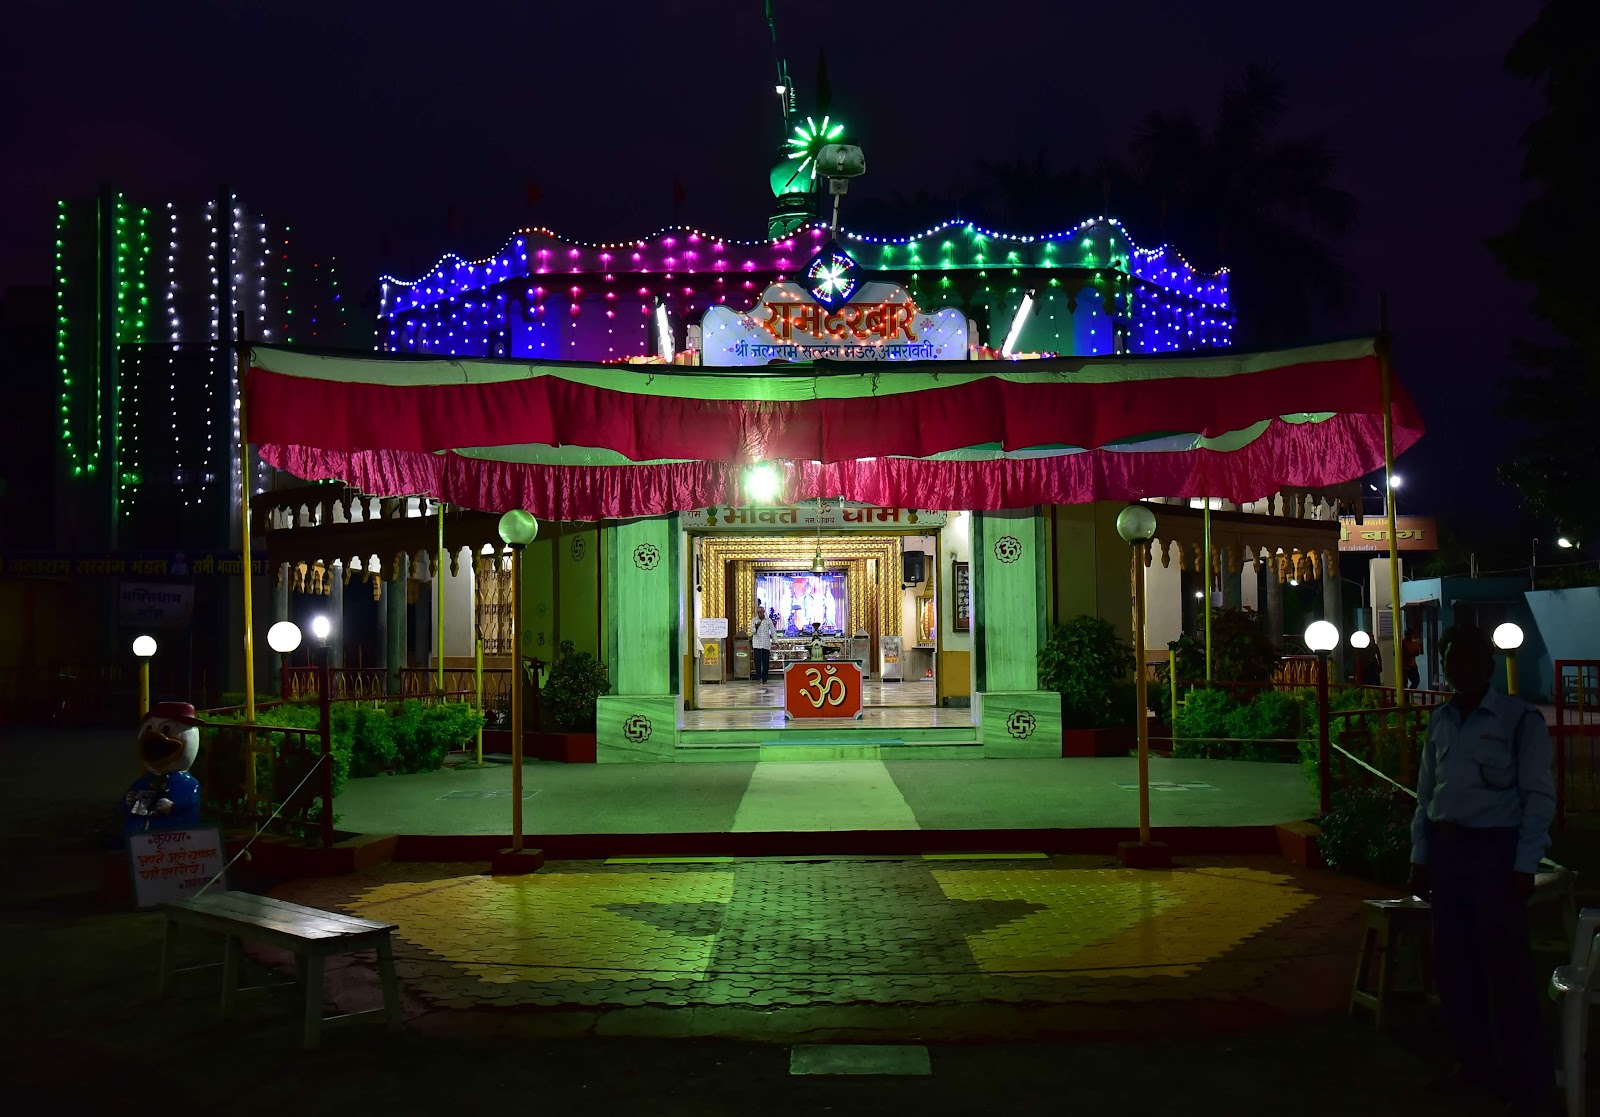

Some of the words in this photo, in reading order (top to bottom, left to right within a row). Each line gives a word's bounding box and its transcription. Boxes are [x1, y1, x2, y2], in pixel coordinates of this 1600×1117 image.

[762, 302, 918, 342] रामदरबार
[735, 340, 749, 359] श्री
[751, 343, 798, 359] जलाराम
[801, 341, 840, 359] सत्संग
